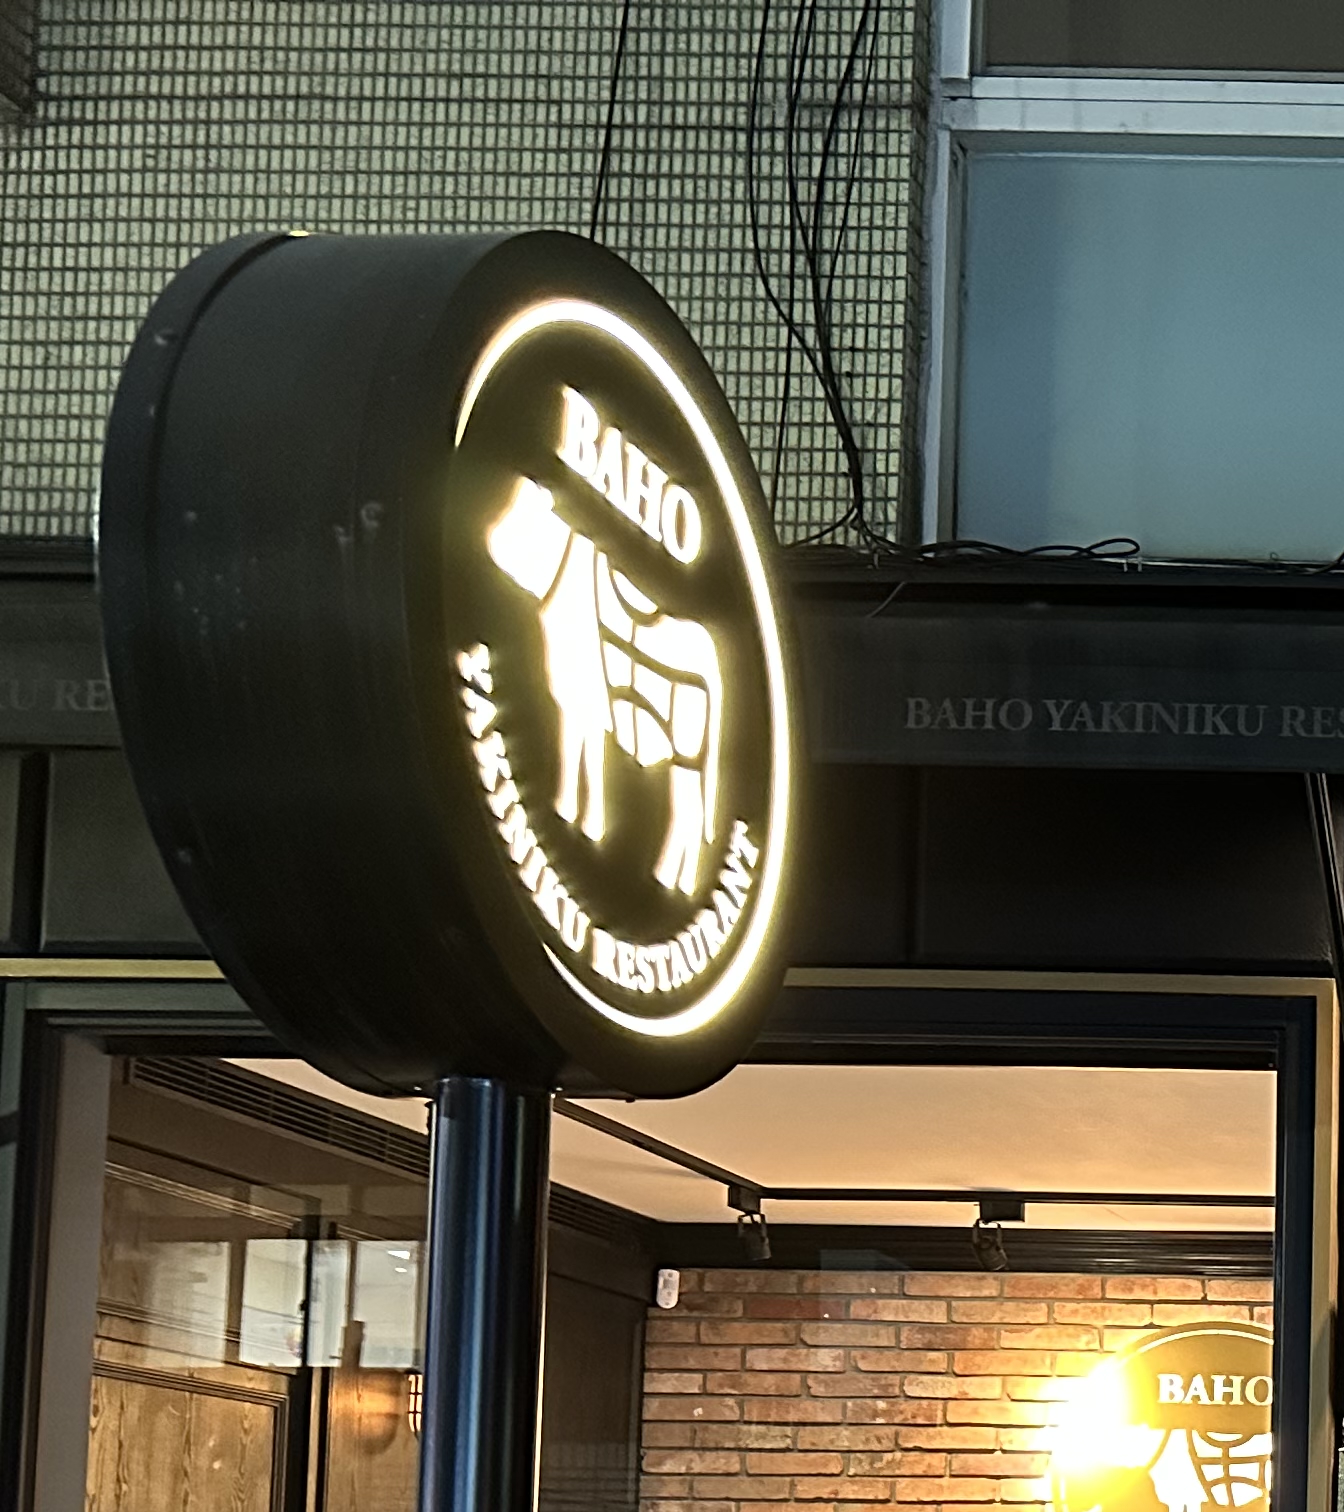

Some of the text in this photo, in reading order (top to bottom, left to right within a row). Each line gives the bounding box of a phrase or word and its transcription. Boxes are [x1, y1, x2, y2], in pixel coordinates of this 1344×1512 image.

[557, 384, 704, 565] BAHO
[904, 696, 1033, 731] BAHO
[1041, 697, 1268, 738] YAKINIKU
[457, 642, 761, 996] YAKINIKU RESTAURANT
[1157, 1374, 1273, 1407] BAHO
